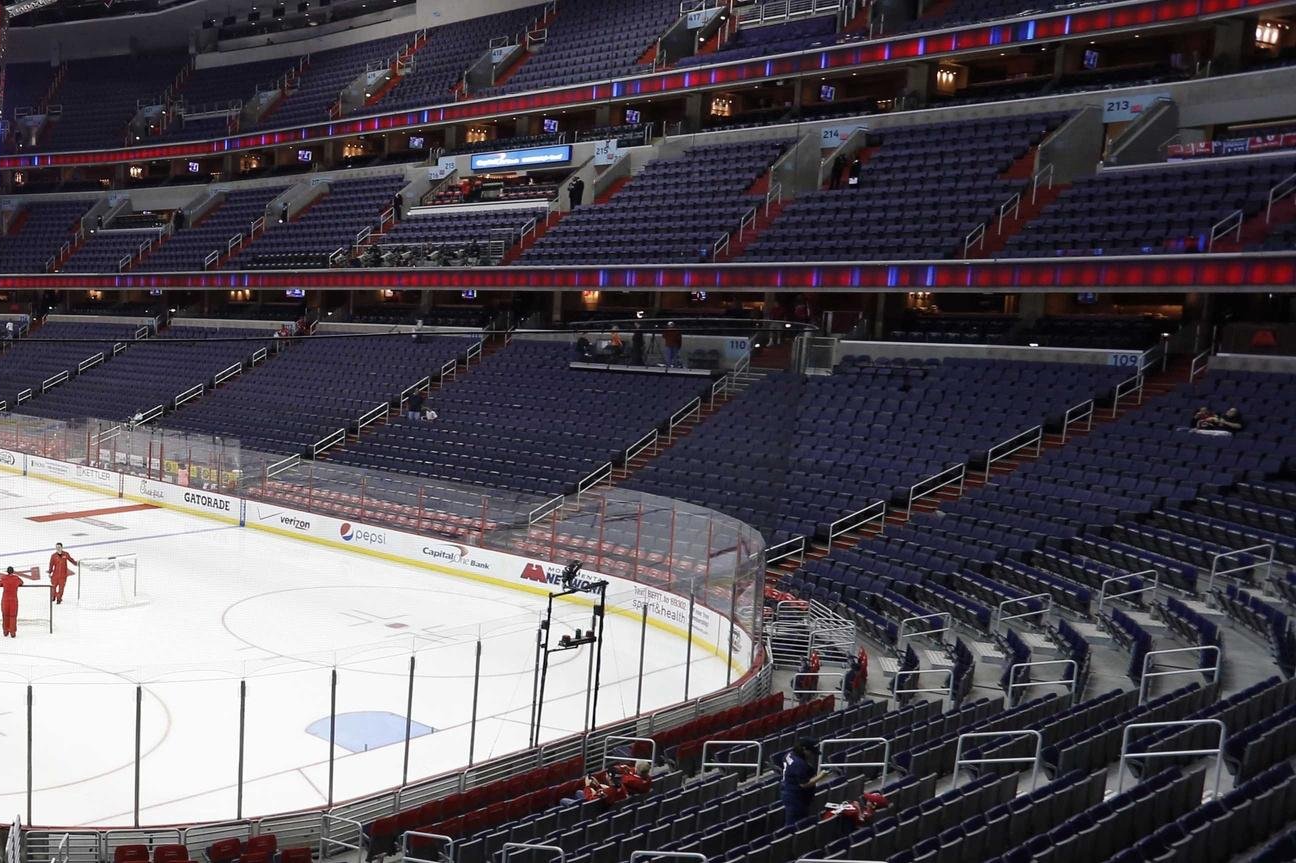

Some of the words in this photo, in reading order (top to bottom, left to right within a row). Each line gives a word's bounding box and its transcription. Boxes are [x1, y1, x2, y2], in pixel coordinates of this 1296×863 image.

[1107, 102, 1128, 111] 213
[823, 130, 838, 138] 214
[730, 340, 746, 350] 110
[1113, 354, 1138, 366] 109
[82, 468, 110, 480] KETTLER
[184, 492, 230, 512] GATORADE
[280, 515, 310, 530] verizon
[356, 528, 386, 544] pepsi
[422, 546, 454, 560] Capital
[470, 560, 490, 570] Bank
[548, 566, 602, 583] MOENTA
[546, 573, 602, 596] NEWO
